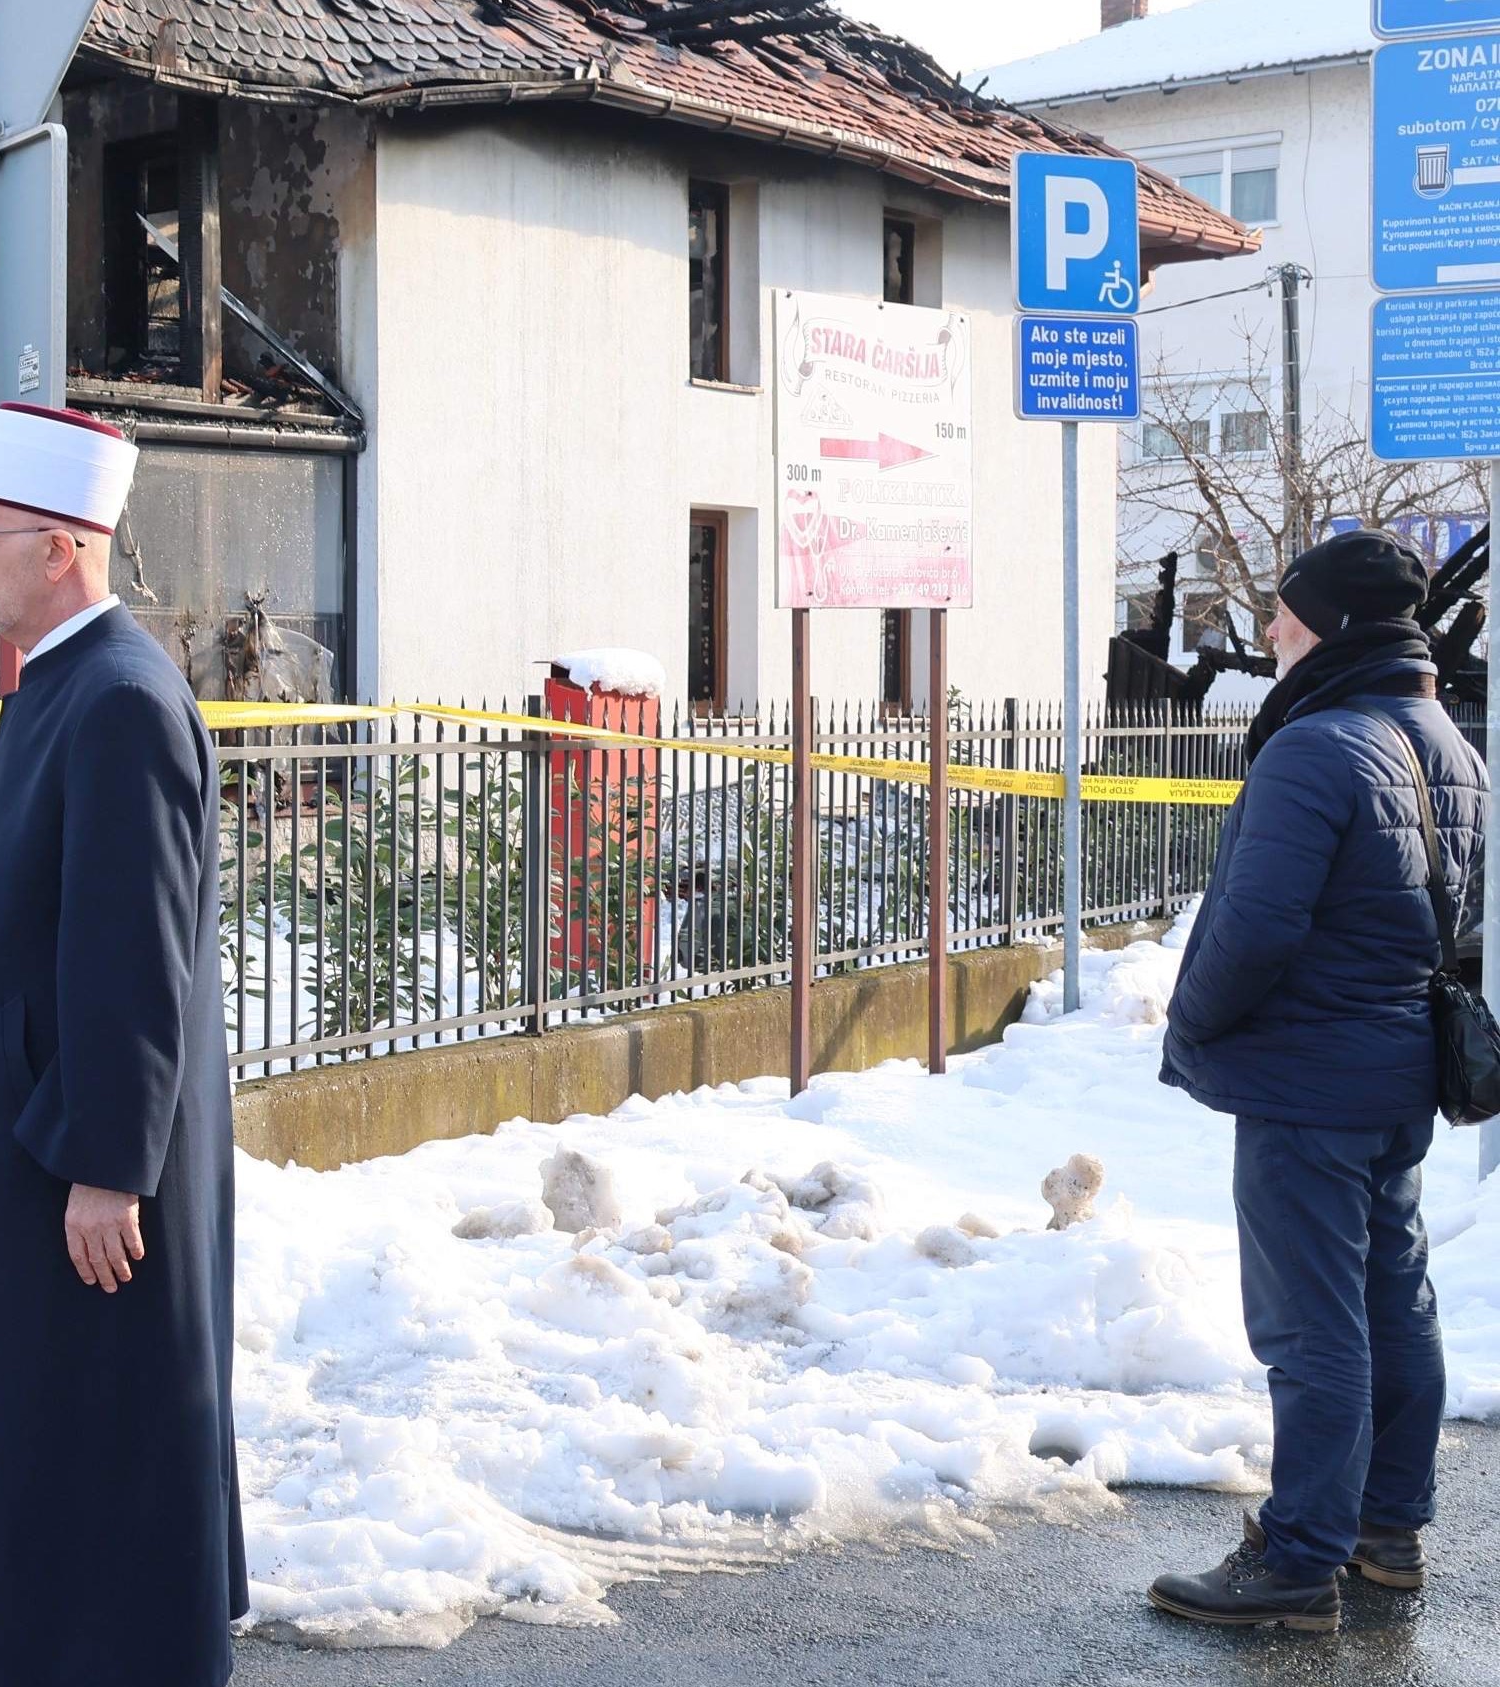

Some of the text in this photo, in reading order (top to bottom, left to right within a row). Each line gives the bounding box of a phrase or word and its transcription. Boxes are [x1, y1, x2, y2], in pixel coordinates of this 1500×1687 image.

[1417, 45, 1488, 71] ZONA
[1452, 70, 1500, 83] NAPLATA
[1449, 81, 1500, 94] НАПЛАТА
[1398, 119, 1466, 136] subotom
[1461, 156, 1483, 167] SAT
[1382, 217, 1431, 230] Kupovinom
[1432, 215, 1457, 224] karte
[1458, 215, 1470, 223] na
[1045, 174, 1110, 291] P
[1382, 229, 1432, 241] Куповином
[1433, 227, 1461, 238] карте
[1461, 227, 1474, 235] на
[1382, 243, 1407, 252] Kartu
[1385, 302, 1416, 312] Korisnik
[1418, 300, 1434, 311] koji
[1435, 300, 1444, 310] je
[1444, 299, 1478, 310] parkirao
[1389, 315, 1415, 325] usluge
[1417, 312, 1458, 323] parkiranja
[1031, 325, 1125, 345] Ako ste uzeli
[1376, 328, 1402, 338] koristi
[1402, 326, 1432, 338] parking
[1433, 325, 1461, 337] mjesto
[1463, 323, 1478, 334] pod
[1411, 338, 1447, 348] dnevnom
[1448, 336, 1481, 348] trajanju
[811, 327, 940, 380] STARA ČARŠIJA
[1031, 349, 1068, 369] moje
[1381, 353, 1409, 362] dnevne
[1411, 351, 1433, 360] karte
[1434, 349, 1462, 359] shodno
[825, 368, 940, 404] RESTORAN PIZZERIA
[1030, 371, 1129, 392] uzmite i moju
[1037, 392, 1123, 410] invalidnost!
[934, 422, 967, 440] 150 m
[787, 464, 822, 482] 300 m
[837, 478, 968, 508] POLIKLINIKA
[838, 516, 861, 541] Dr.
[918, 583, 930, 597] 49
[930, 583, 949, 597] 212
[1080, 785, 1134, 795] STOP POLIC
